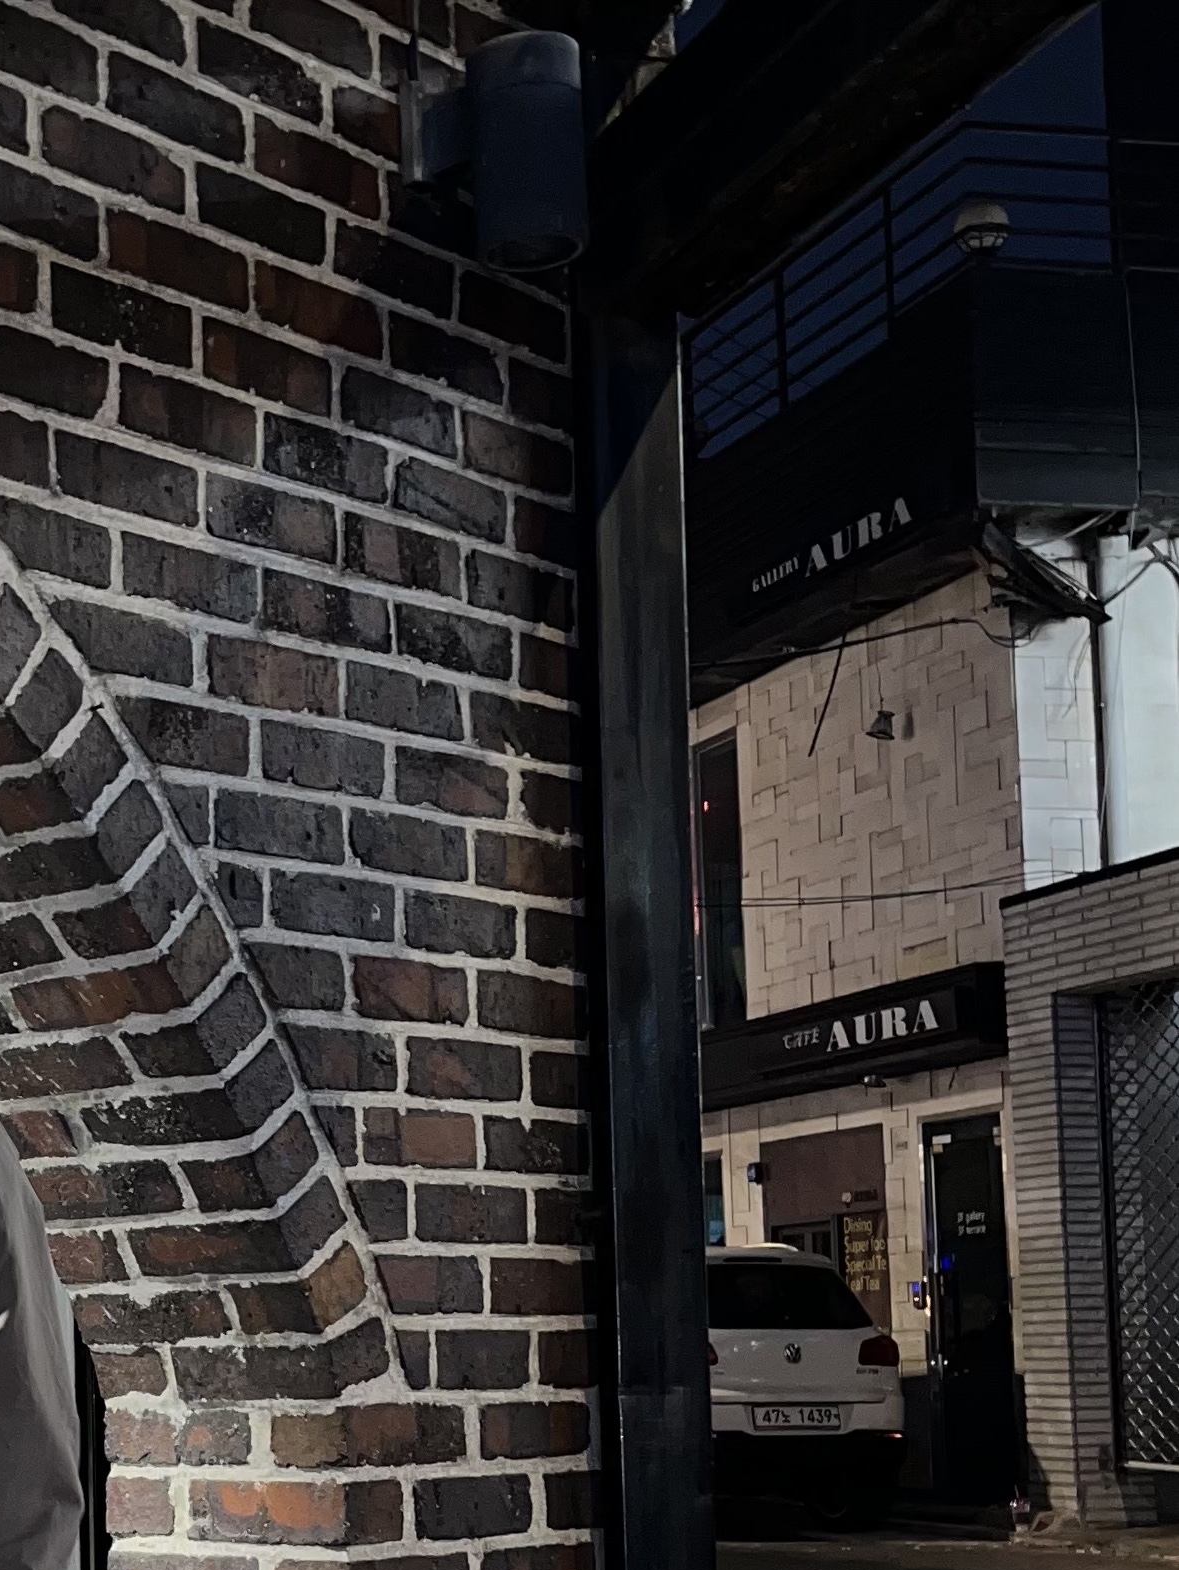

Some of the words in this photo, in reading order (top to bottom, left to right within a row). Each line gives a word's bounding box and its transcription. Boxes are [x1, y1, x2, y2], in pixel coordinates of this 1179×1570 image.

[805, 497, 912, 578] AURA
[826, 999, 939, 1052] AURA
[799, 1408, 832, 1424] 1439
